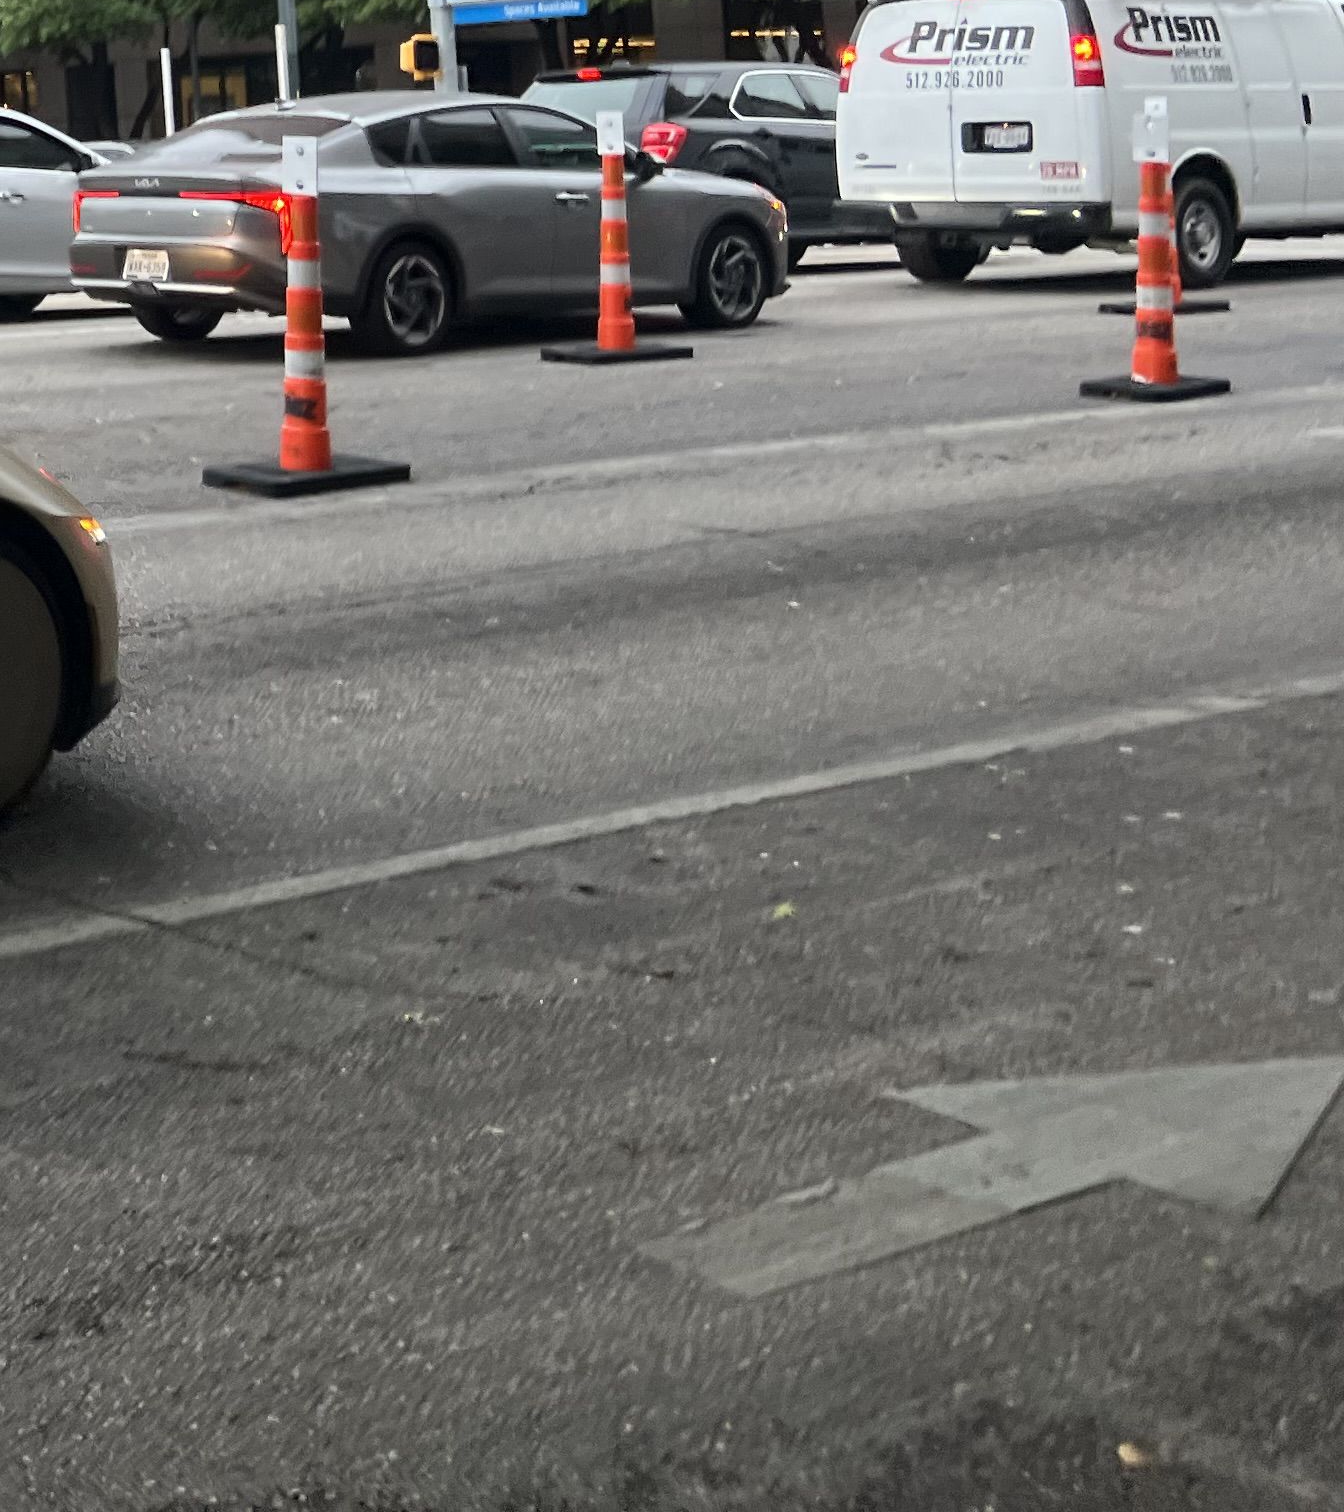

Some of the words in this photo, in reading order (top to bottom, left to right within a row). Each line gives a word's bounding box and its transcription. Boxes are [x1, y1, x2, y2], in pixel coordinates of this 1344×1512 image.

[503, 3, 535, 19] Spaces
[537, 0, 581, 14] Available
[1126, 6, 1222, 43] Prism
[907, 18, 1035, 54] Prism
[953, 52, 1031, 67] electric
[1174, 44, 1222, 59] electric
[906, 69, 1005, 89] 512.926.2000
